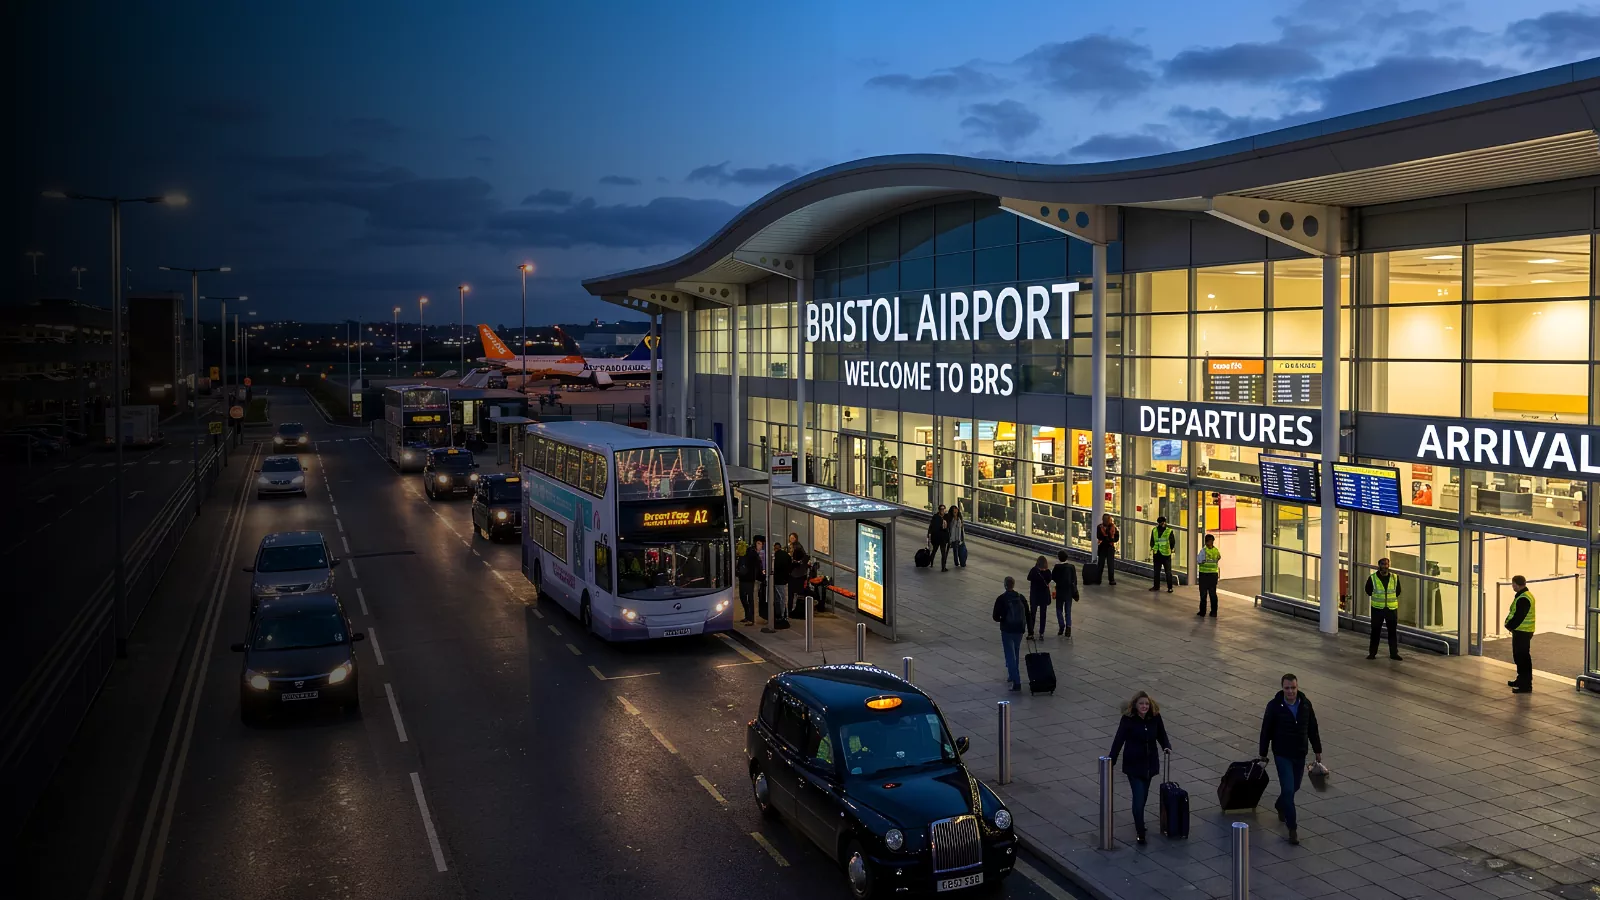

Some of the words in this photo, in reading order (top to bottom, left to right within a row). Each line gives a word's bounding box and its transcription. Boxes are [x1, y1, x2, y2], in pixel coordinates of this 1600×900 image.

[806, 296, 909, 343] BRISTOL
[915, 282, 1080, 341] AIRPORT
[844, 360, 931, 391] WELCOME
[936, 362, 964, 393] TO
[970, 363, 1014, 396] BRS
[1139, 405, 1313, 447] DEPARTURES
[1416, 424, 1600, 474] ARRIVAL
[693, 509, 708, 524] A2
